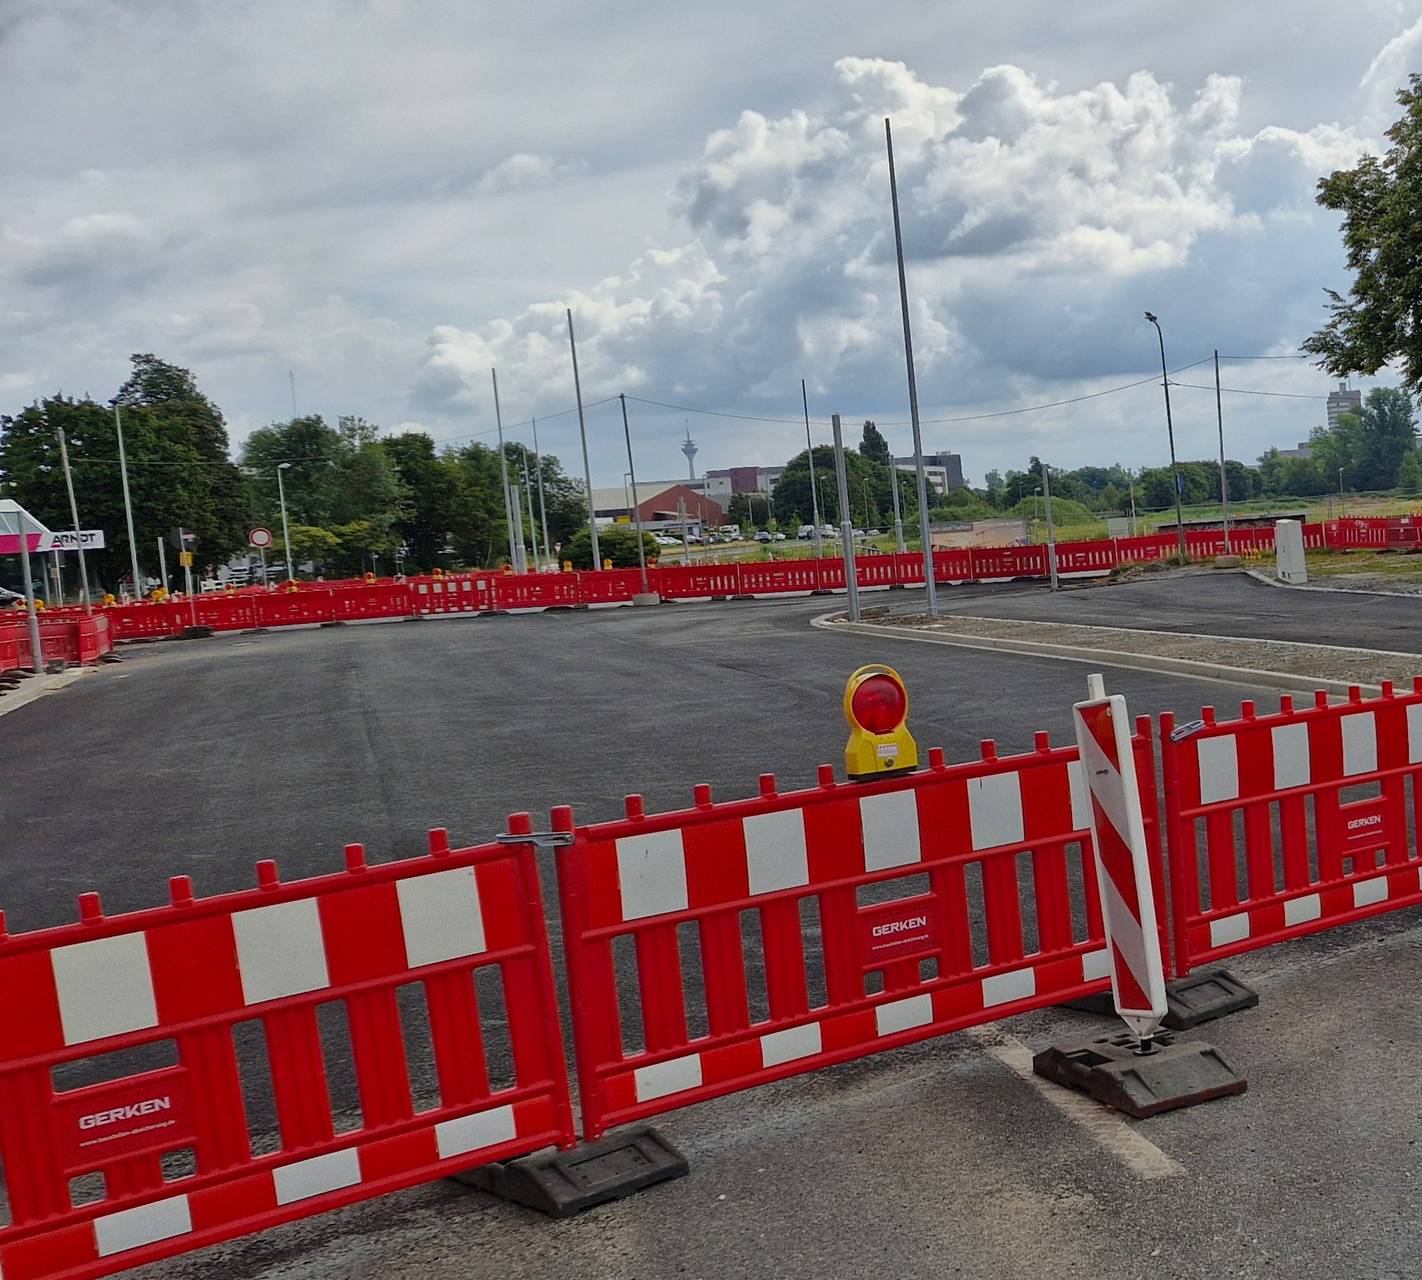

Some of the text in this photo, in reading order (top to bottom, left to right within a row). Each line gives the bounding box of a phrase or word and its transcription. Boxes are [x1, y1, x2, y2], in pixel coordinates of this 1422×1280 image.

[1347, 814, 1381, 830] GERKEN
[872, 916, 926, 937] GERKEN
[79, 1096, 171, 1130] GERKEN
